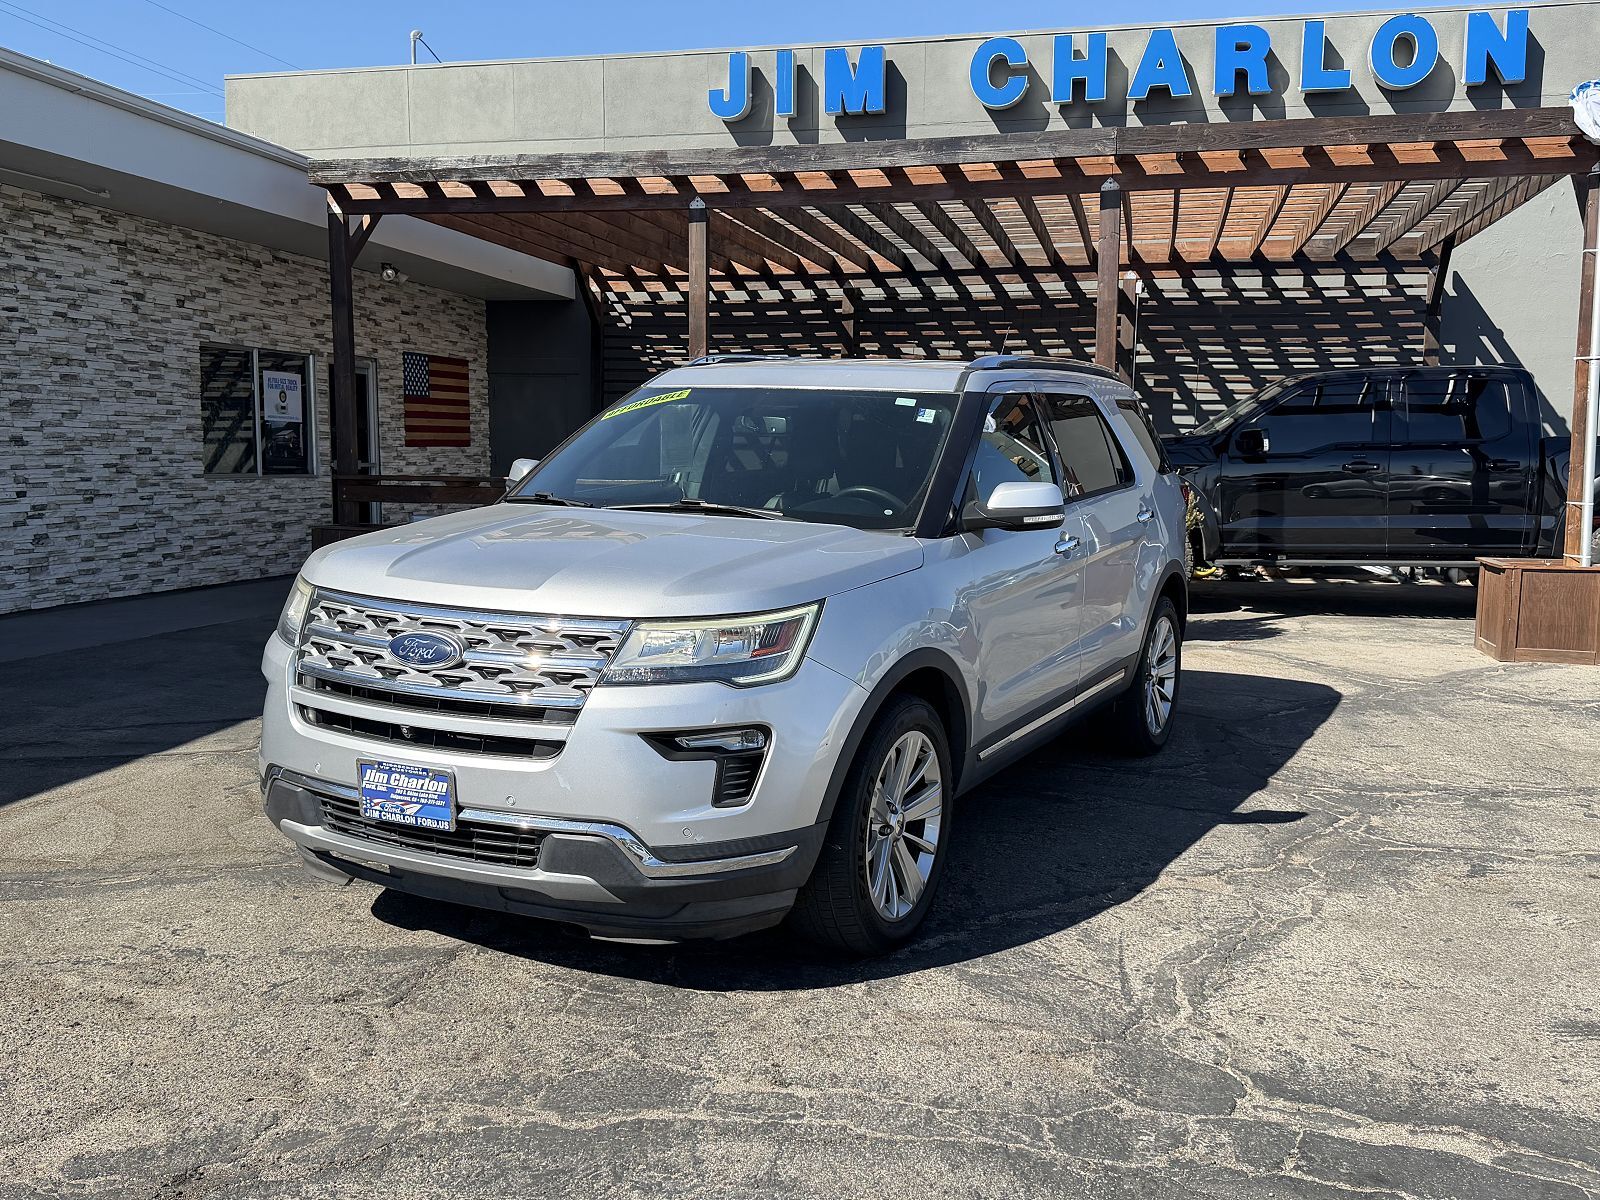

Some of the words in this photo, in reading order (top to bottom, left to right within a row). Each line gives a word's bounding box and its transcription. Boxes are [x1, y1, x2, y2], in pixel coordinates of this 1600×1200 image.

[708, 46, 887, 119] JIM
[969, 10, 1529, 110] CHARLON
[399, 638, 437, 659] Ford
[364, 770, 388, 783] Jim
[390, 773, 447, 792] Charlon
[365, 809, 380, 818] JIM
[381, 811, 416, 824] CHARLON
[417, 818, 449, 829] FORD.US
[383, 803, 402, 814] Ford
